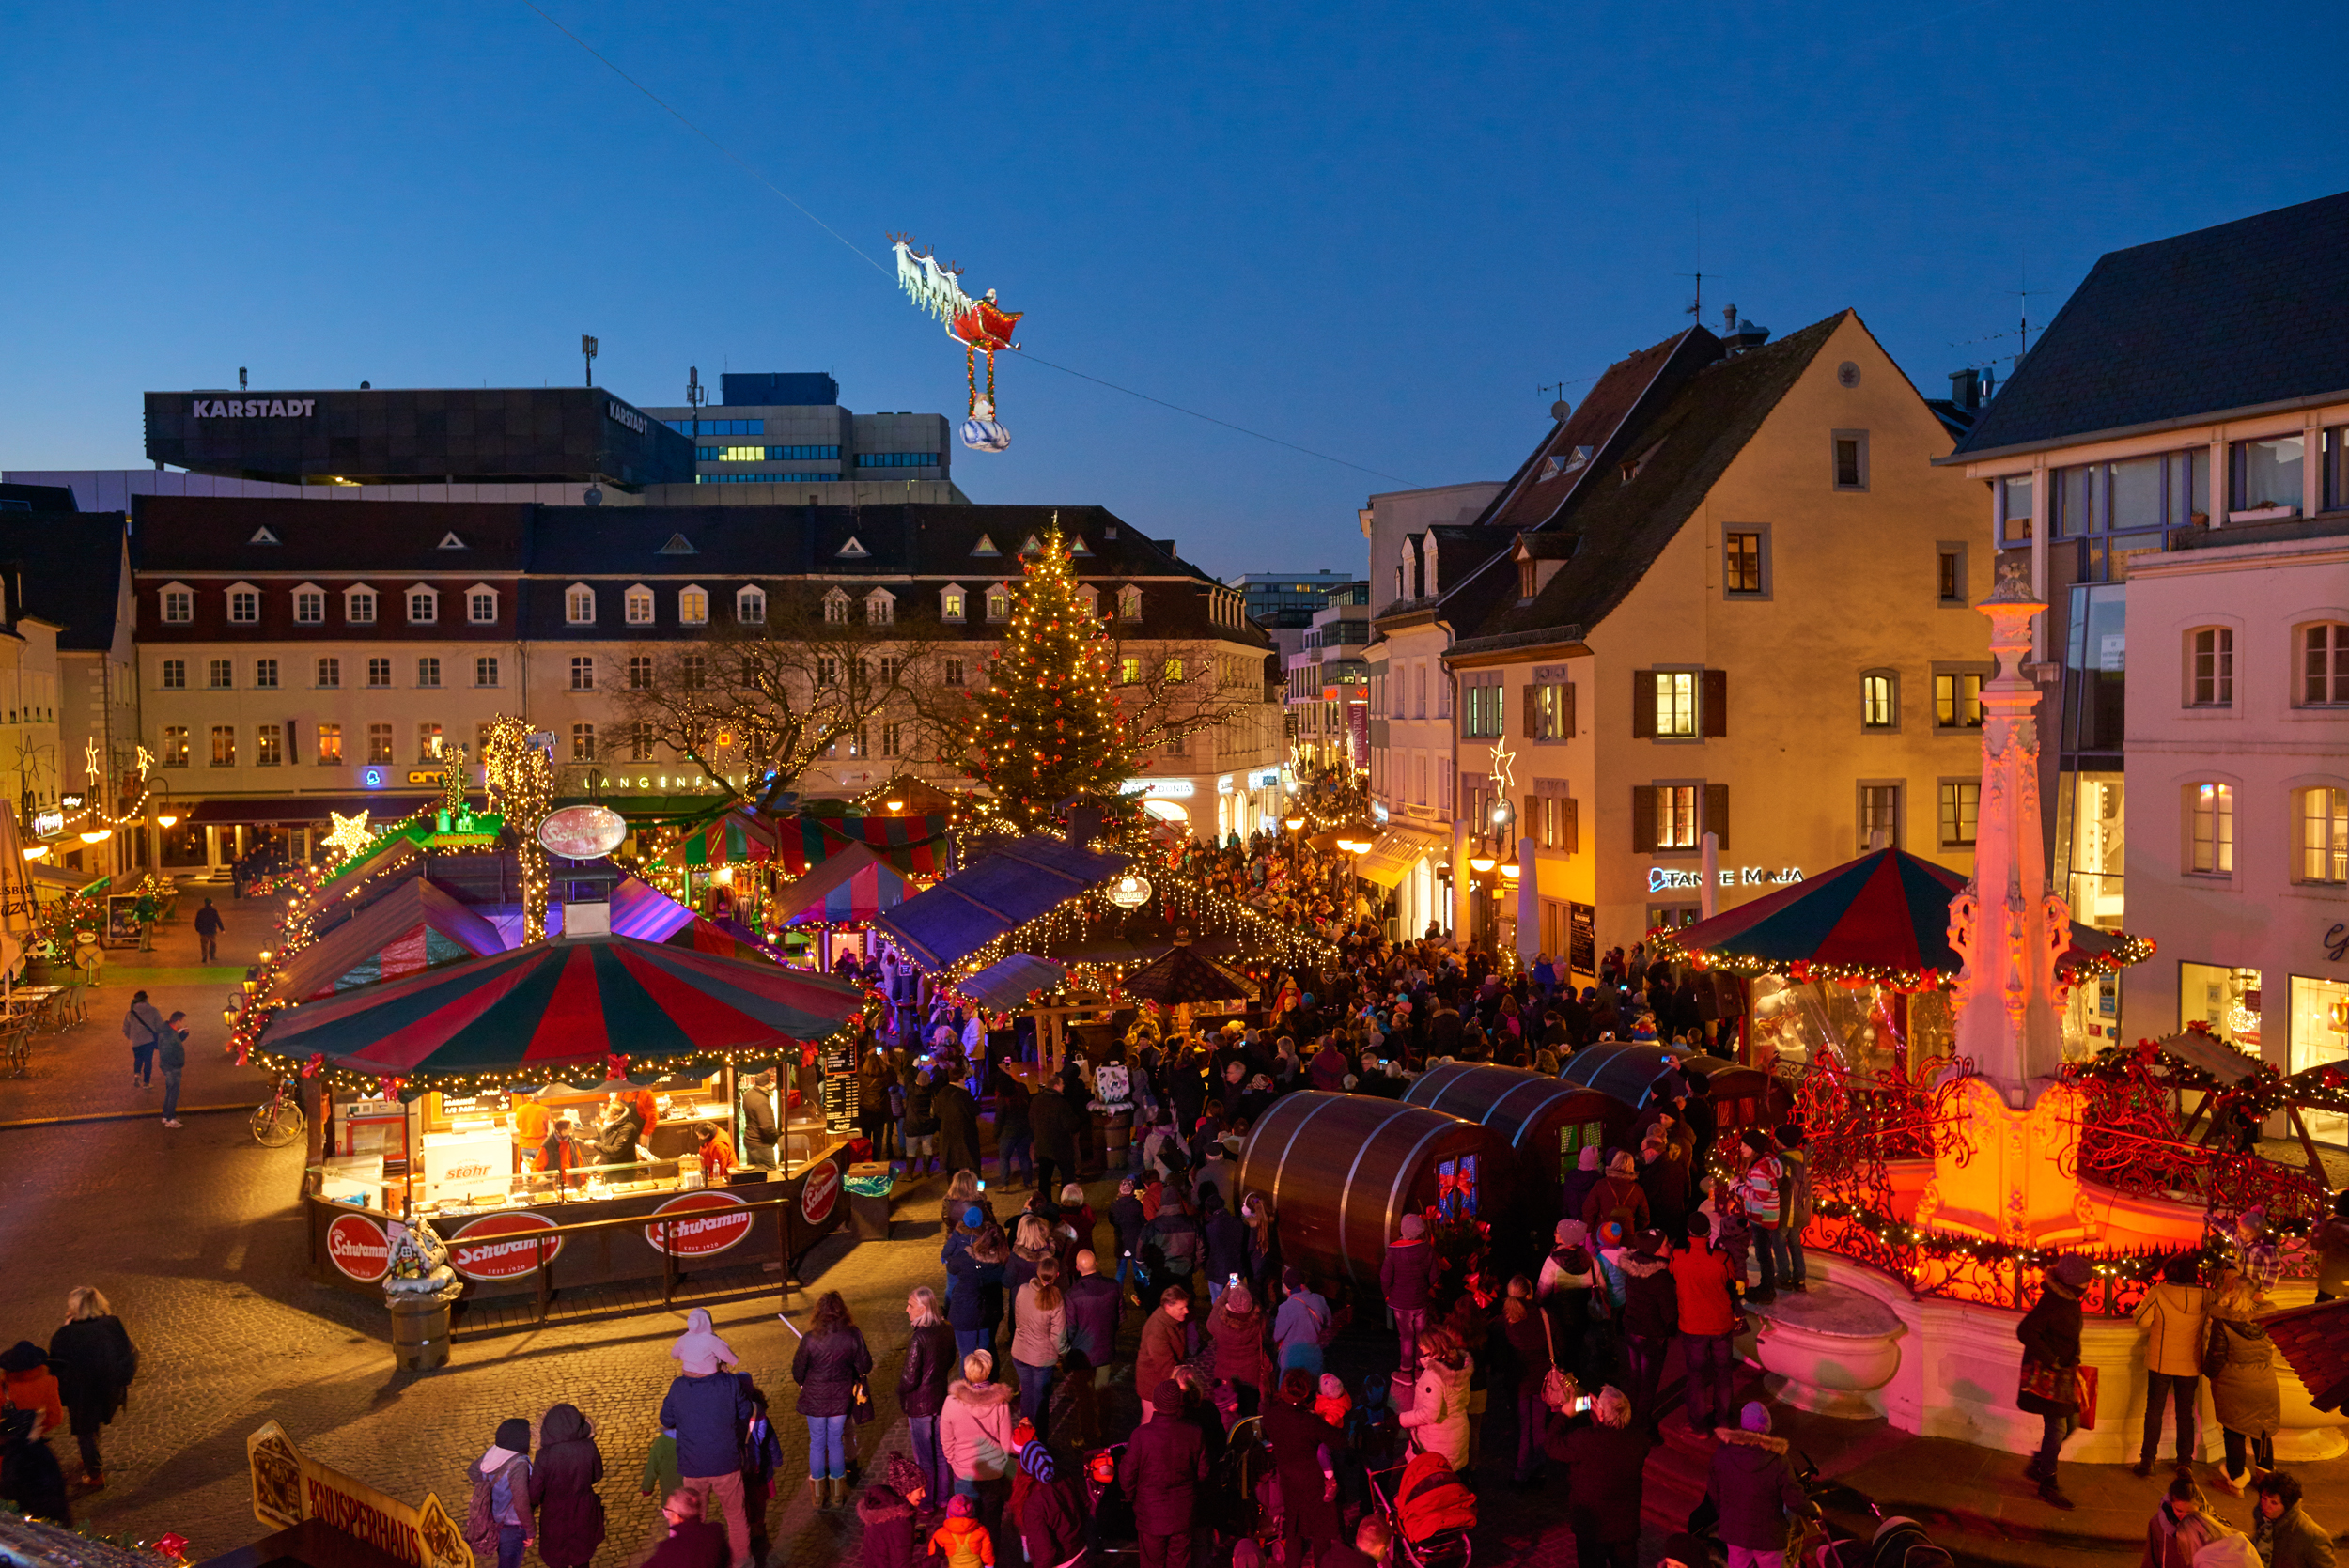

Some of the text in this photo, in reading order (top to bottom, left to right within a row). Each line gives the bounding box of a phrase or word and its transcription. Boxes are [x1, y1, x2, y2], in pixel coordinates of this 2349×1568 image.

[193, 399, 316, 418] KARSTADT
[609, 400, 647, 436] KARSTADT
[1353, 707, 1361, 749] GENERALI
[1665, 872, 1735, 886] TANE
[333, 1234, 388, 1258] Schwamm
[703, 1242, 719, 1250] 1920
[508, 1264, 525, 1273] 1920
[307, 1476, 422, 1567] KNUSPERHAUS
